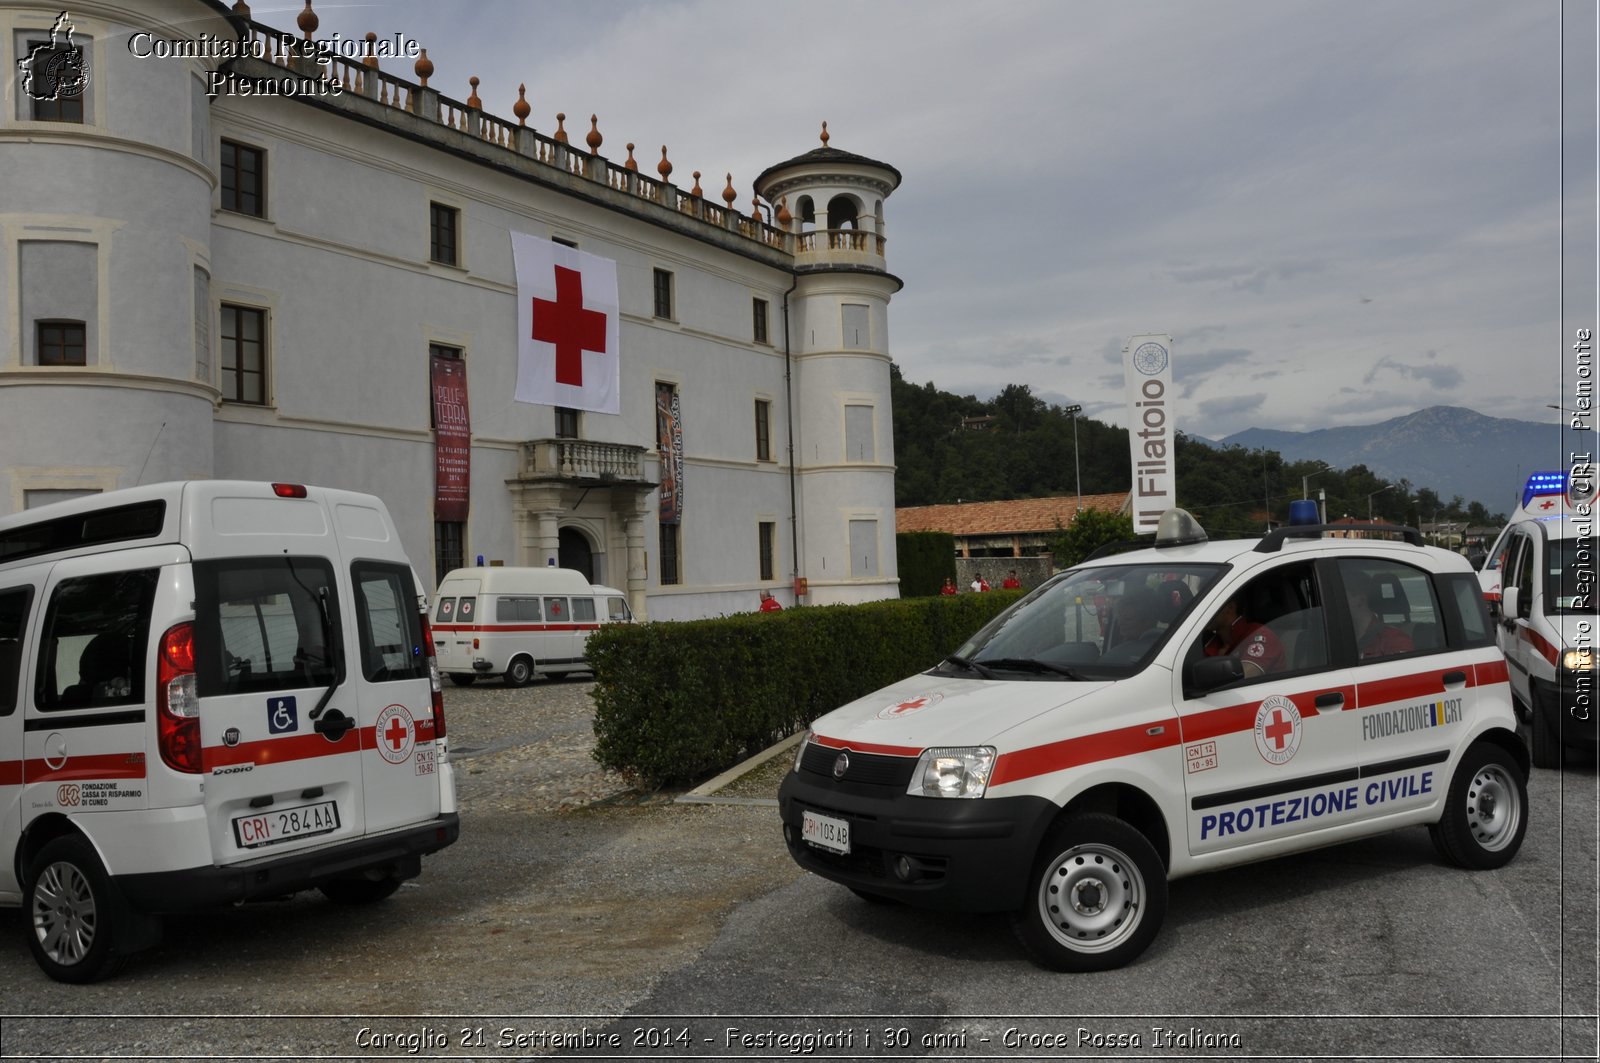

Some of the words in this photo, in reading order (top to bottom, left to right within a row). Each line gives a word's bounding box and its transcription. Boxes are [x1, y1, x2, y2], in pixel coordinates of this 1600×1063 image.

[437, 385, 462, 404] PELLE
[436, 402, 467, 425] TERRA
[1136, 379, 1167, 497] Filatoio
[1362, 704, 1430, 741] FONDAZIONE
[1443, 698, 1463, 724] CRT
[416, 753, 426, 762] CN
[427, 751, 434, 760] 12
[1188, 748, 1200, 757] CN
[1204, 745, 1213, 753] 12
[108, 790, 142, 798] RISPARMIO
[1200, 786, 1359, 841] PROTEZIONE
[1364, 771, 1434, 806] CIVILE
[242, 817, 270, 842] CRI
[803, 818, 816, 836] CRI
